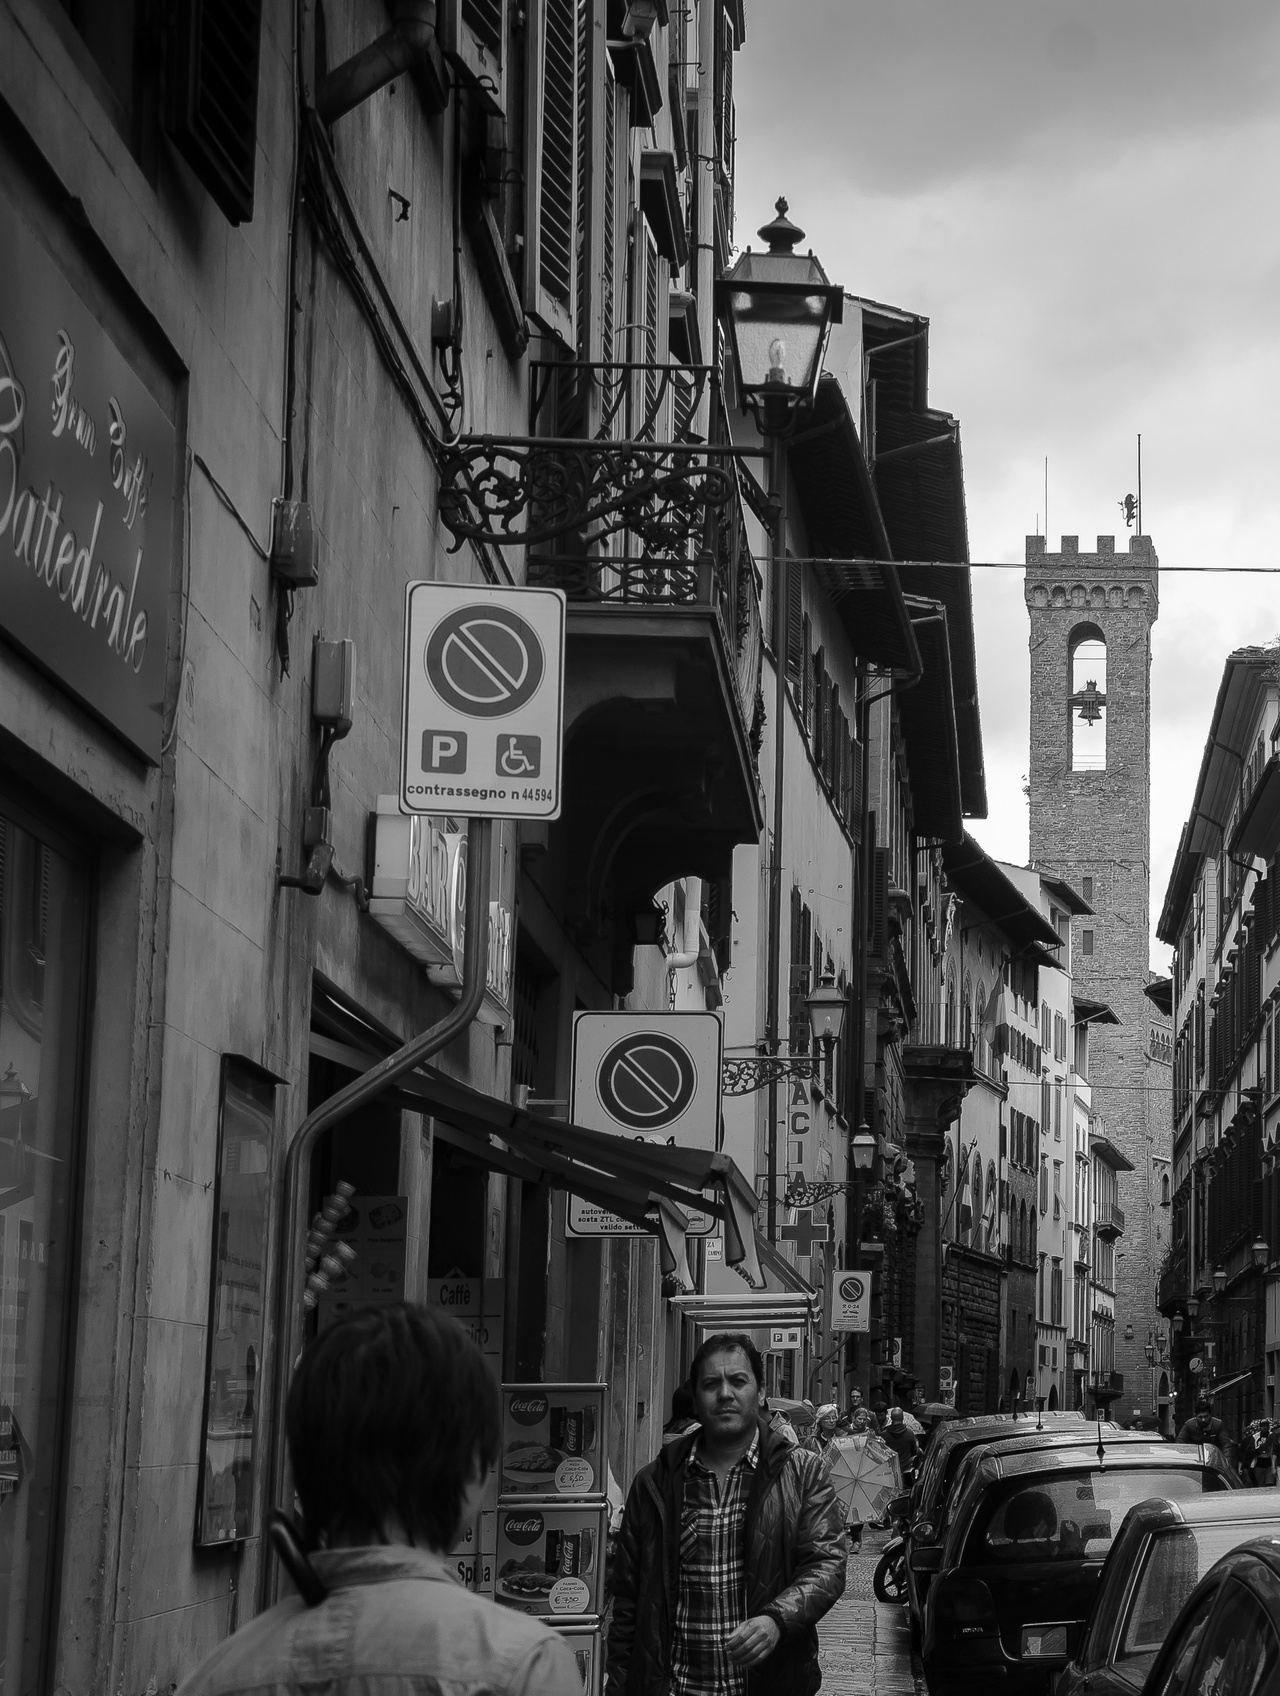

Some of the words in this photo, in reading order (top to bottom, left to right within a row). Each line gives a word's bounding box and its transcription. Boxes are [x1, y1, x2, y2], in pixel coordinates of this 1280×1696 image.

[432, 735, 458, 768] P
[407, 784, 506, 799] contrassegno
[522, 788, 552, 802] 44594
[440, 1283, 471, 1306] Caffè
[457, 1561, 491, 1588] Spia
